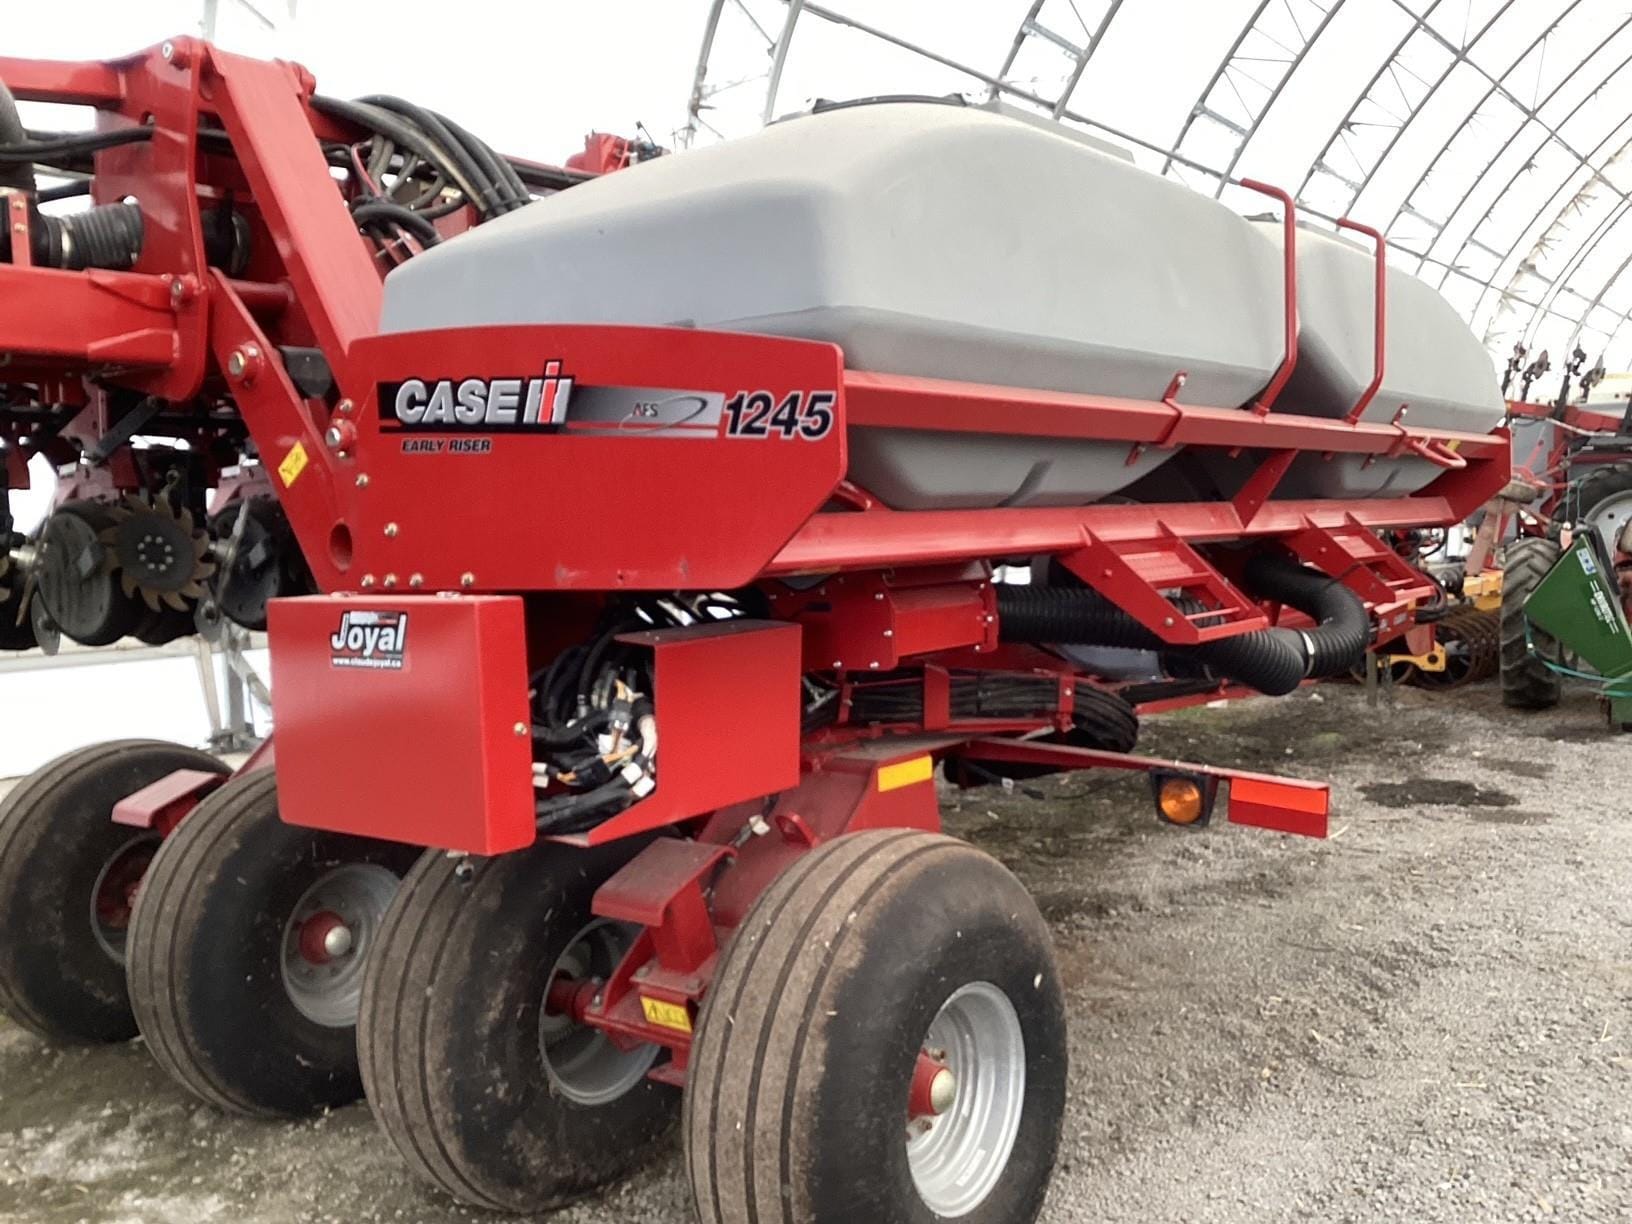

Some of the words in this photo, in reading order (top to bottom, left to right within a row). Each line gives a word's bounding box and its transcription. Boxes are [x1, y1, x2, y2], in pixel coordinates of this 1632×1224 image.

[395, 378, 522, 425] CASE
[631, 402, 659, 417] AFS
[725, 390, 835, 439] 1245
[402, 438, 444, 452] EARLY
[449, 439, 491, 452] RISER
[331, 611, 407, 656] Joyal
